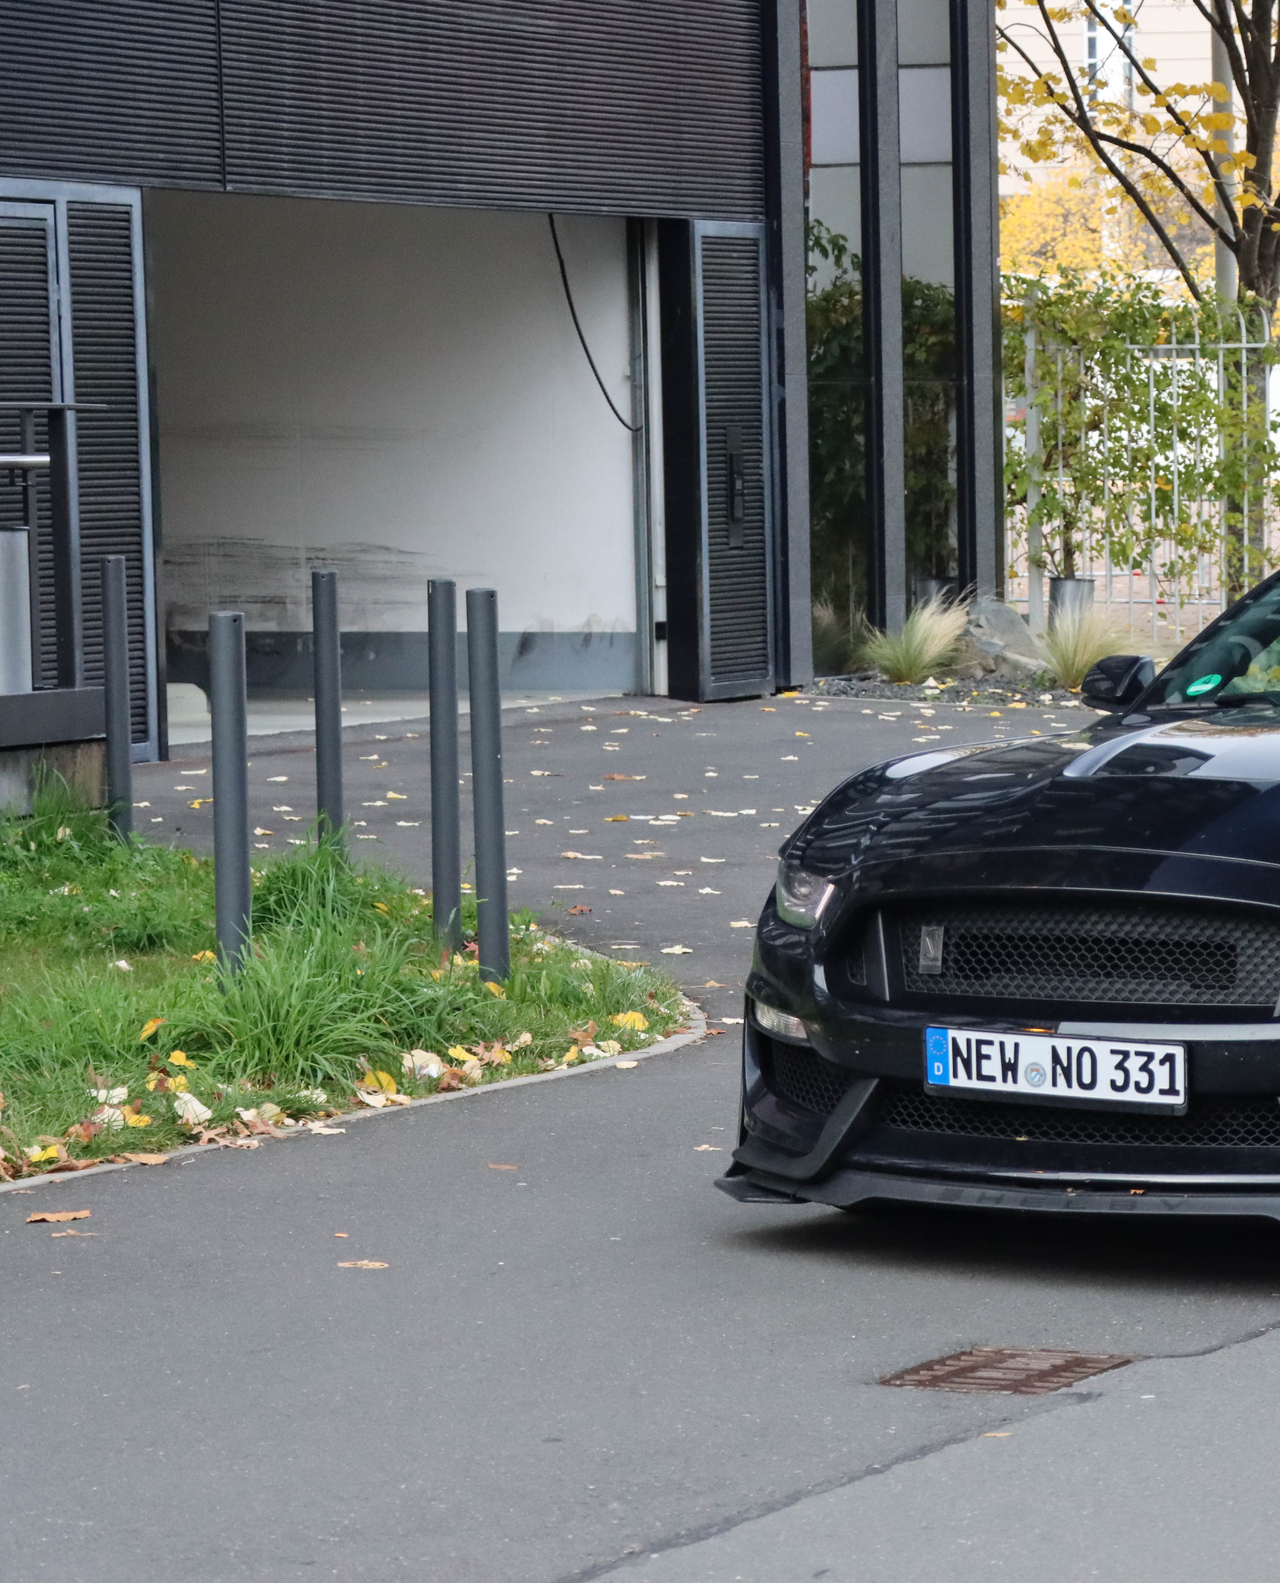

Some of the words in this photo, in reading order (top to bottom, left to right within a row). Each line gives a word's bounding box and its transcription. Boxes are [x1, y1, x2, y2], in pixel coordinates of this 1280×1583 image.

[934, 1062, 943, 1075] D
[951, 1036, 1020, 1084] NEW
[1051, 1044, 1098, 1091] NO
[1109, 1048, 1181, 1096] 331
